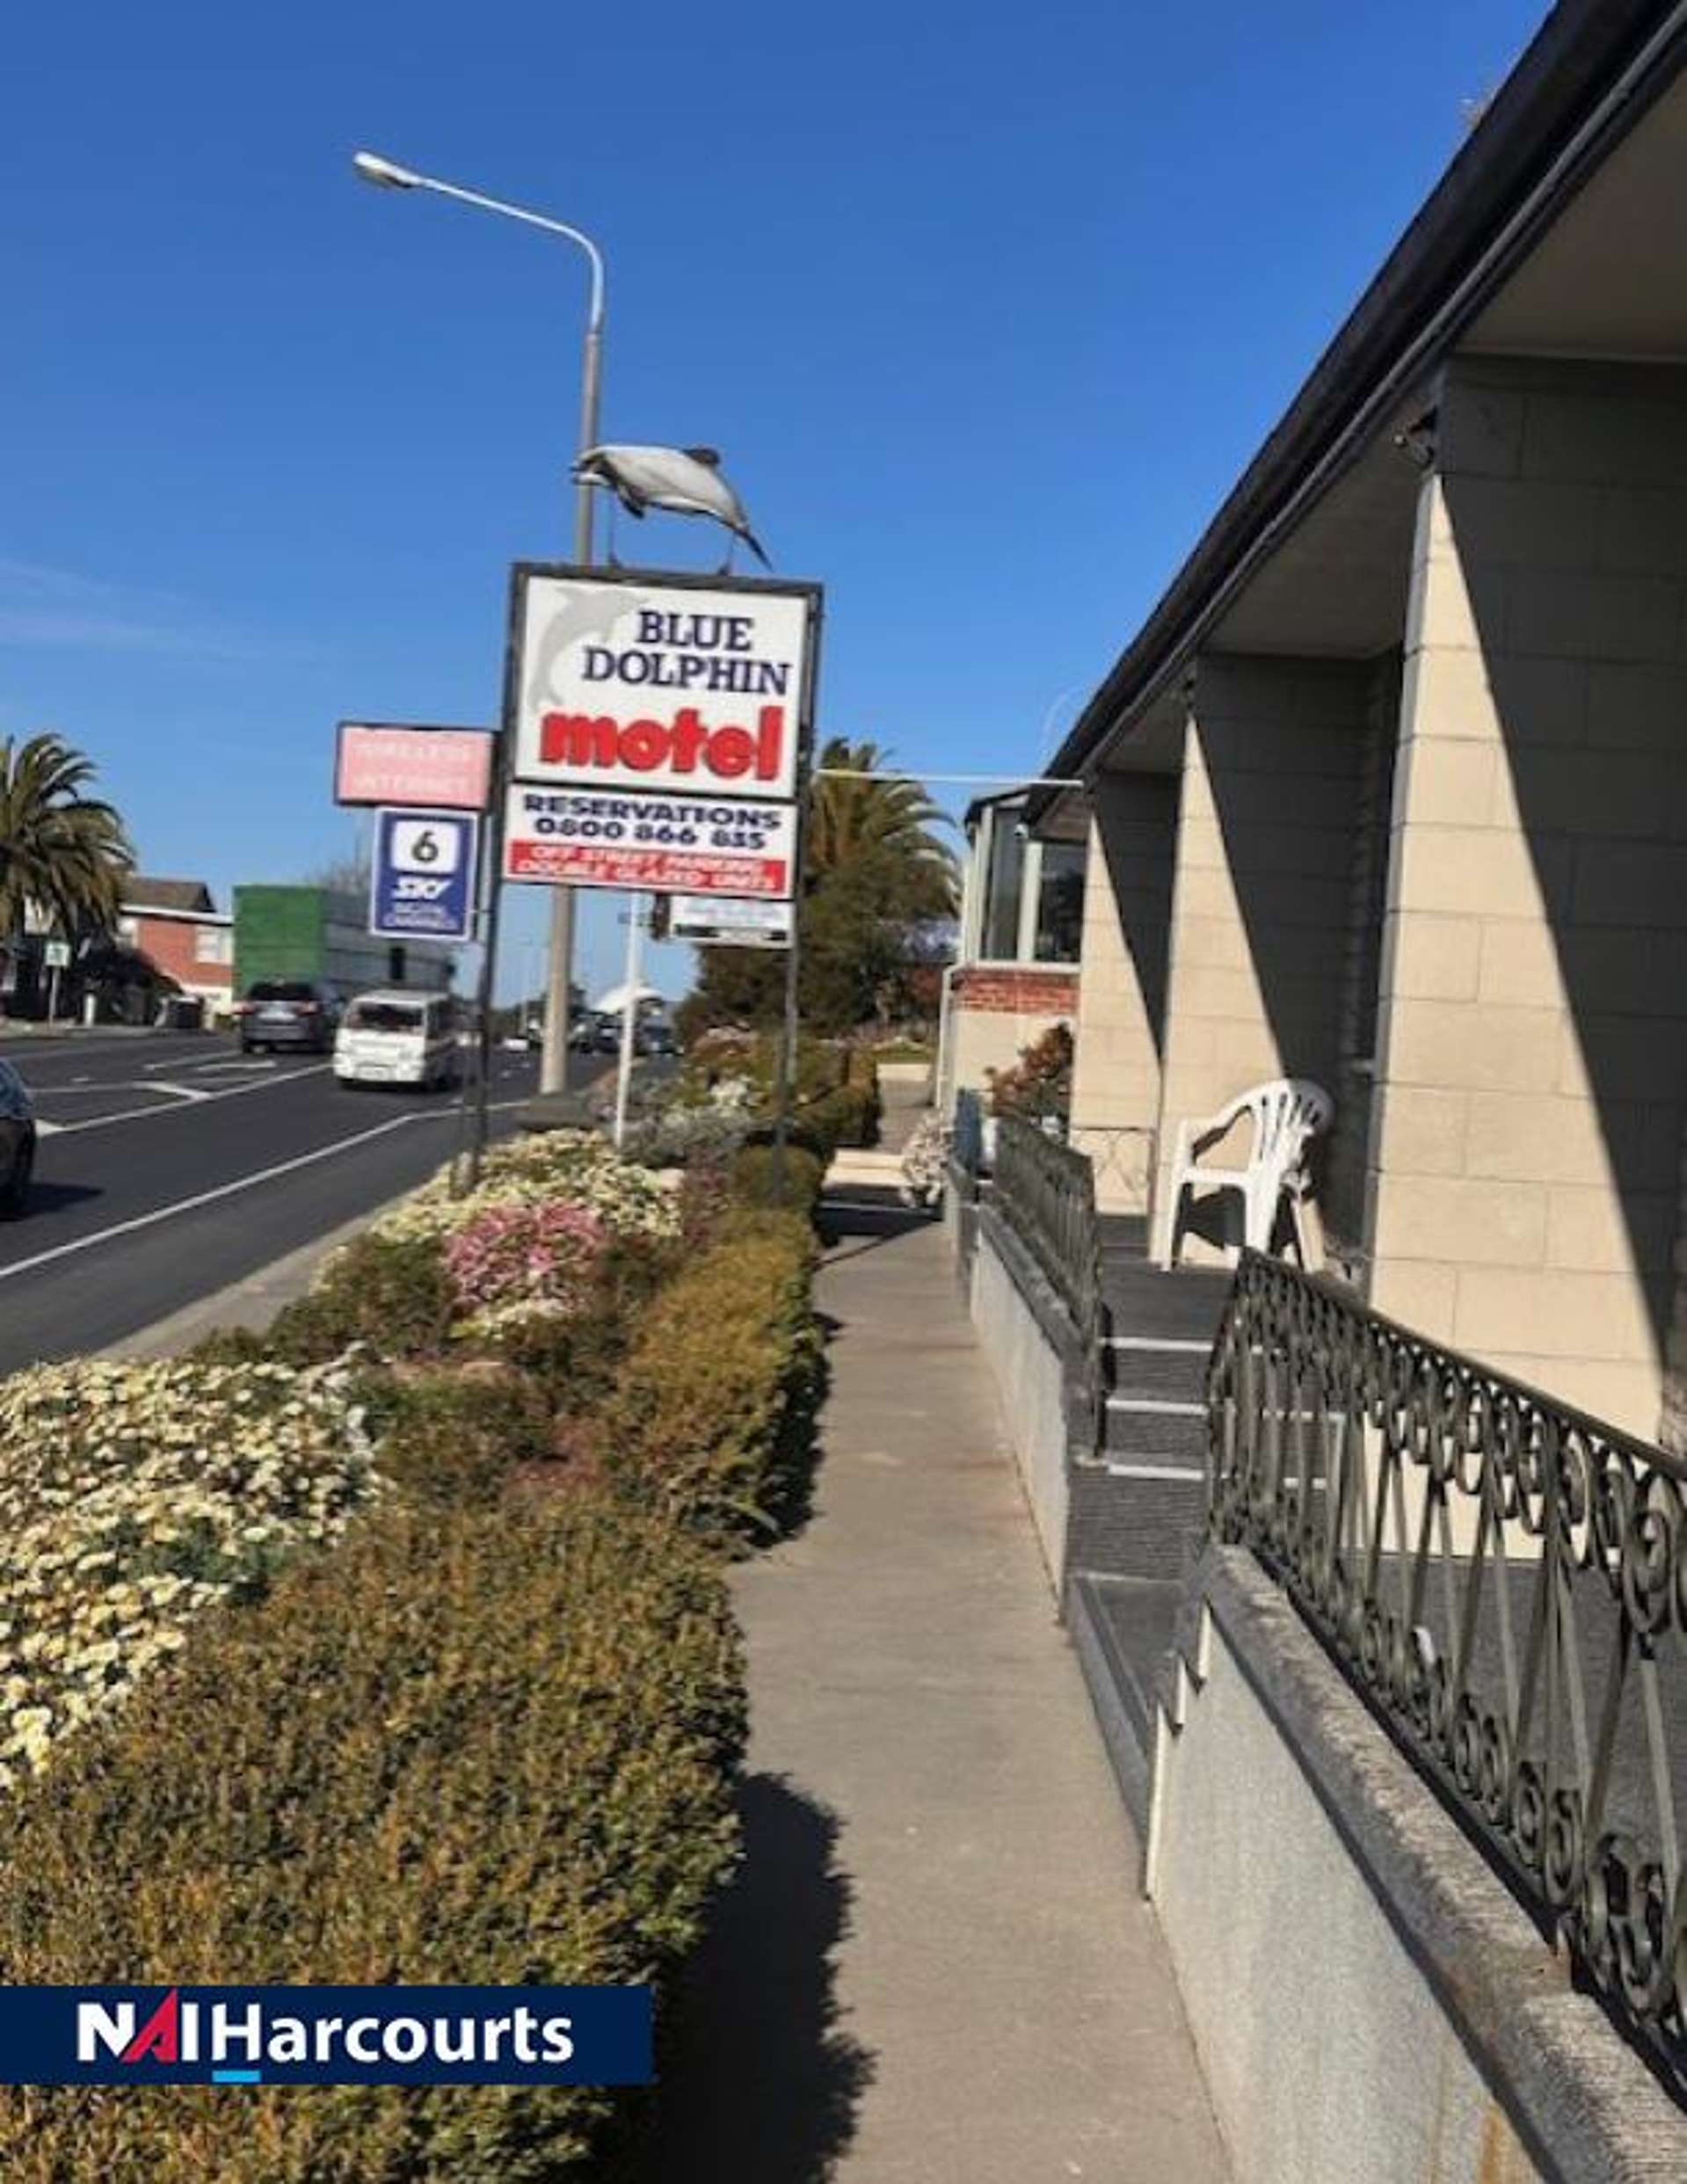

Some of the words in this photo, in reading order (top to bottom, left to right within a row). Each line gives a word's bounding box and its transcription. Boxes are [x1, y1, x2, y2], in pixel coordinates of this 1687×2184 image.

[636, 608, 753, 652] BLUE
[582, 645, 792, 695] DOLPHIN
[538, 705, 784, 781] motel
[523, 793, 782, 830] RESERVATIONS
[535, 817, 625, 839] 0800
[635, 823, 698, 846] 866
[411, 830, 440, 863] 6
